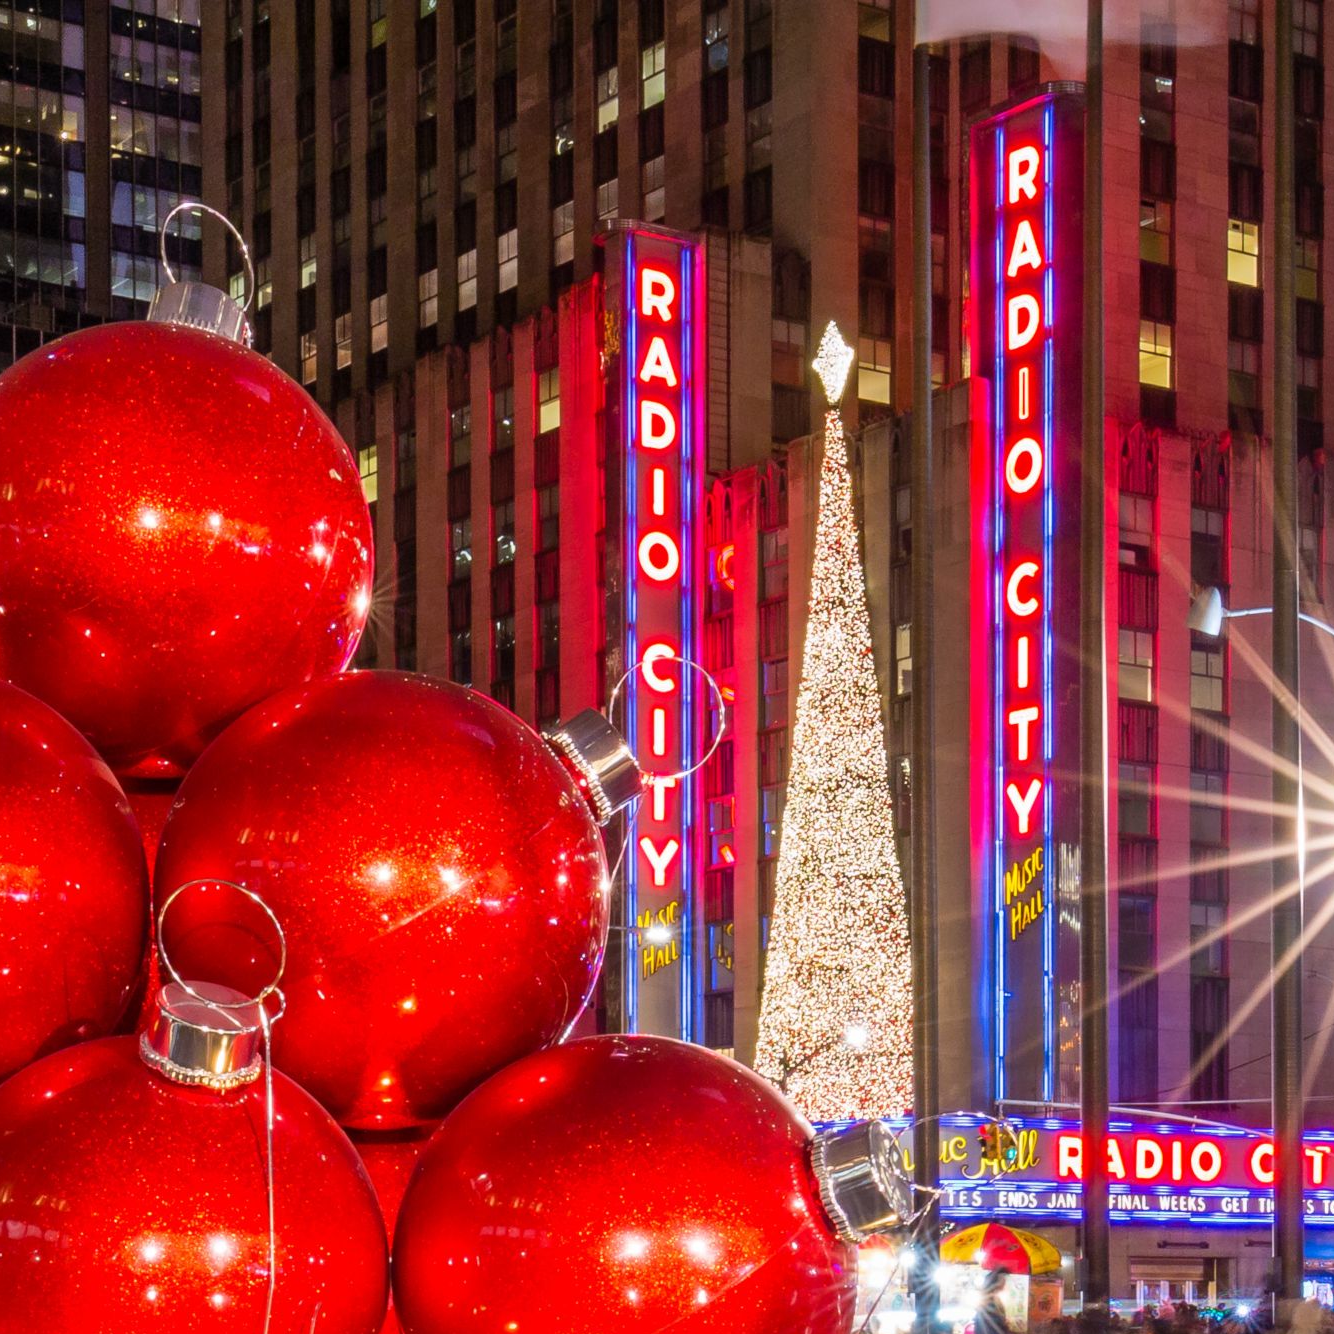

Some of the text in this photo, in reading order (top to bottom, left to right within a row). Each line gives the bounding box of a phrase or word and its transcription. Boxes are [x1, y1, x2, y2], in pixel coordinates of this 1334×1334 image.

[1005, 145, 1044, 836] RADIO CITY
[637, 266, 680, 887] RADIO CITY
[1003, 847, 1044, 905] MUSIC
[1010, 890, 1044, 941] HALL
[642, 938, 679, 981] HALL
[1057, 1135, 1222, 1181] RADIO
[999, 1191, 1038, 1208] ENDS
[1047, 1193, 1077, 1209] JAN
[1108, 1194, 1149, 1210] FINAL
[1159, 1195, 1206, 1212] WEEKS
[1221, 1196, 1249, 1213] GET
